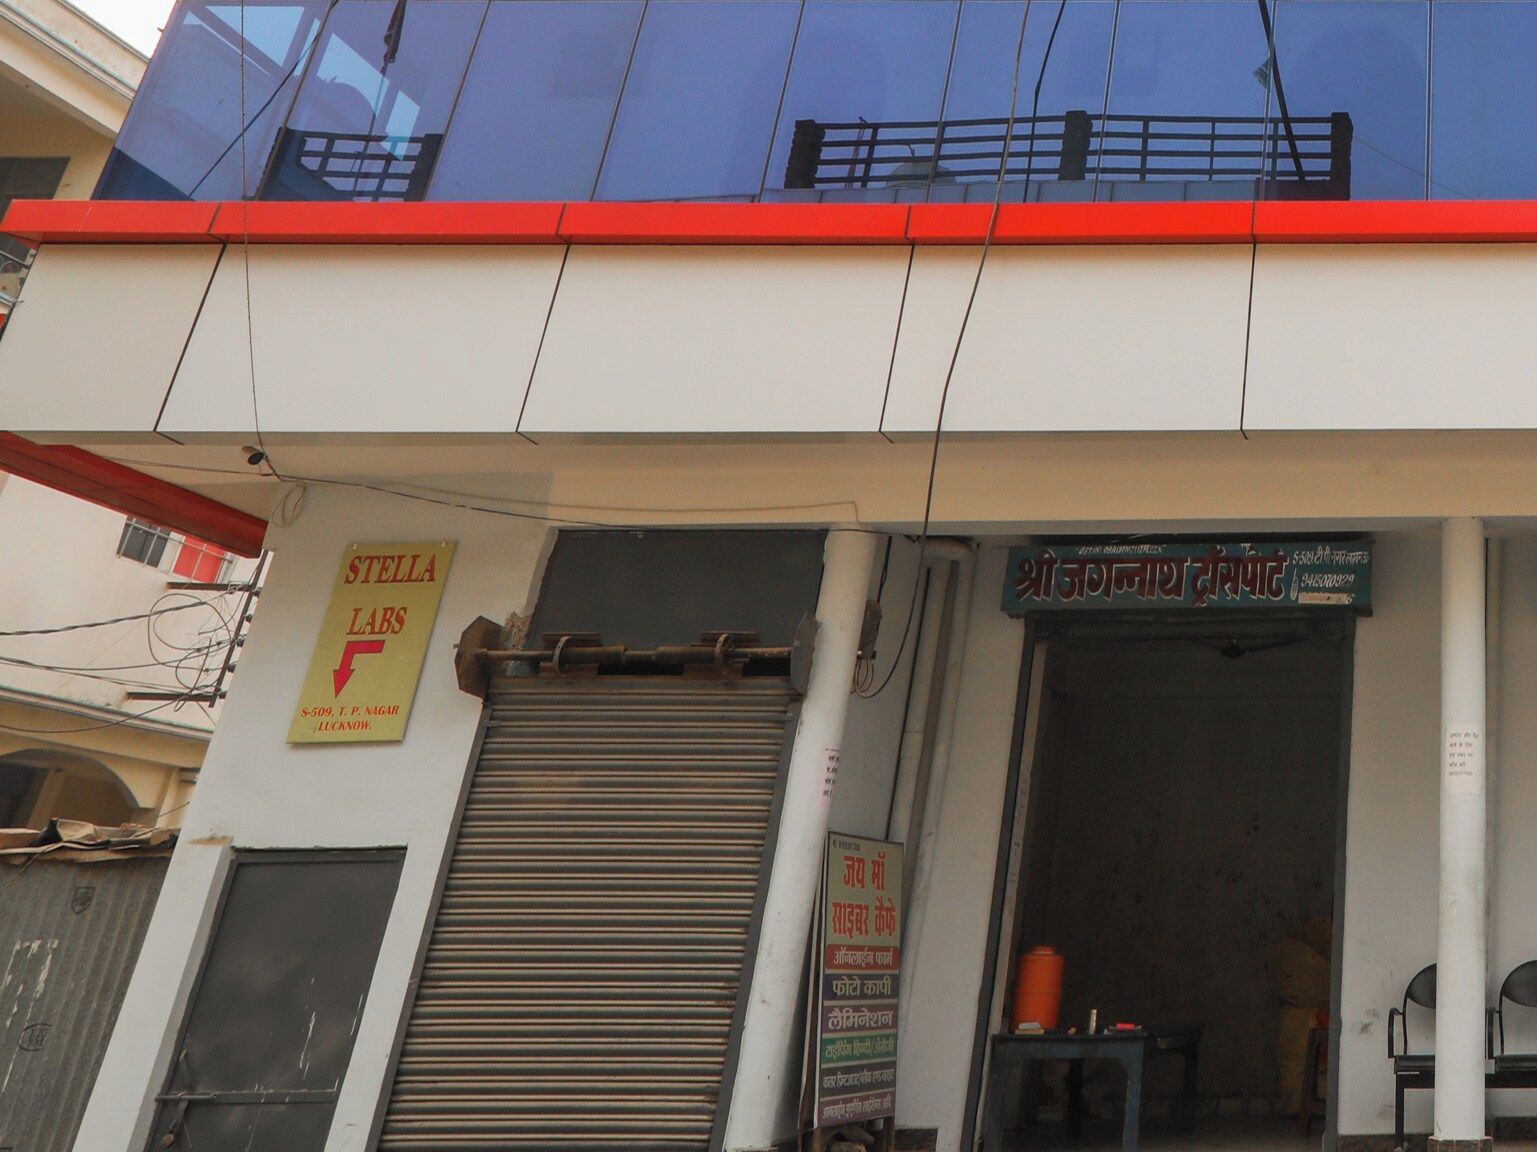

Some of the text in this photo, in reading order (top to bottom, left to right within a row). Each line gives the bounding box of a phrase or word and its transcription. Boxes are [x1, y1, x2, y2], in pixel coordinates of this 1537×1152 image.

[343, 553, 436, 584] STELLA
[1014, 547, 1060, 602] श्री
[1056, 556, 1191, 602] जगन्नाथ
[345, 606, 408, 635] LABS
[351, 706, 361, 716] P.
[365, 705, 400, 716] NAGAR
[317, 720, 372, 731] LUCKNOW.
[843, 854, 866, 889] जय
[831, 901, 869, 941] साइबर
[832, 975, 892, 996] फोटो कापी
[828, 1007, 893, 1030] लैमिनेशन
